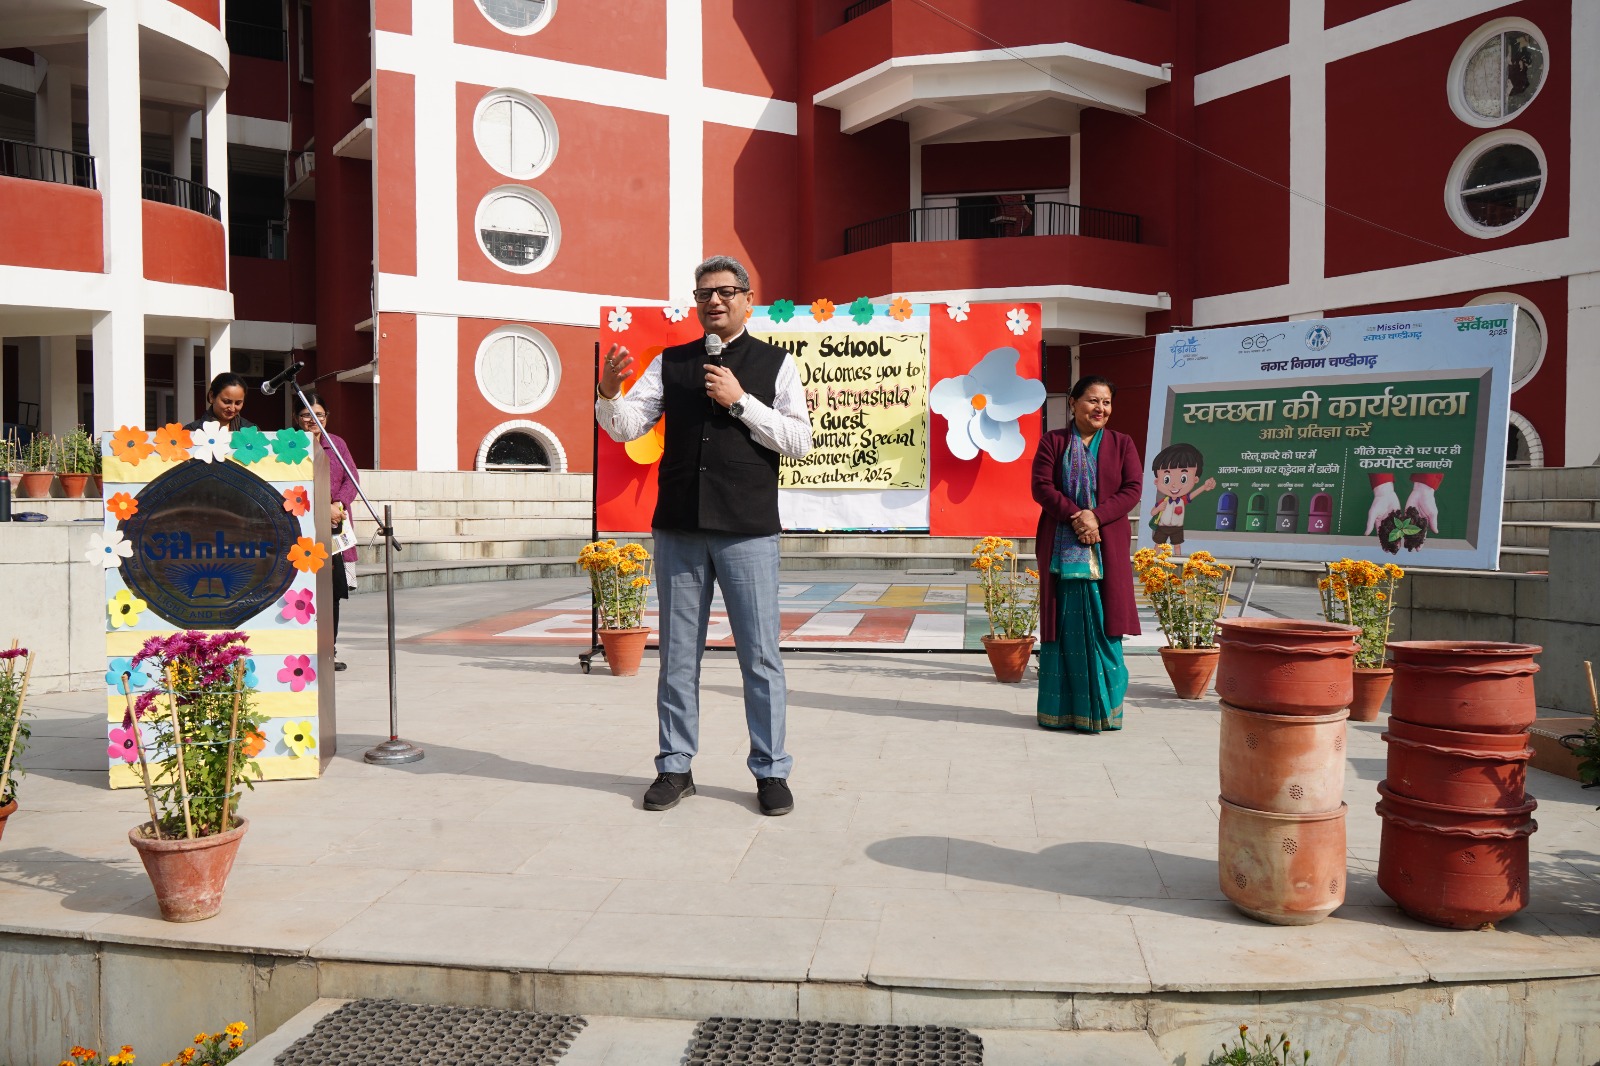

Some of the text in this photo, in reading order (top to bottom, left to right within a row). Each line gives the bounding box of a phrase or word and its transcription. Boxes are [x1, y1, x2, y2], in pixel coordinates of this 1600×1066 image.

[1377, 323, 1411, 331] Mission
[1457, 316, 1508, 332] सर्वेक्षण
[818, 335, 892, 358] School
[1261, 353, 1378, 372] नगर निगम चण्डीगढ़
[876, 365, 902, 384] you
[906, 362, 921, 377] to
[1183, 386, 1470, 424] स्वच्छता की कार्यशाला
[820, 409, 870, 430] Guest
[860, 428, 915, 449] Special
[1259, 422, 1373, 440] आओ प्रतिज्ञा करें
[1282, 450, 1293, 460] को
[1295, 450, 1307, 459] घर
[1307, 448, 1318, 459] में
[1354, 444, 1462, 456] गीले कचरे से घर पर ही
[1264, 465, 1277, 474] कर
[1307, 463, 1317, 474] में
[1359, 455, 1415, 469] कम्पोस्ट
[863, 467, 893, 483] 2025
[156, 593, 187, 615] LIGHT
[189, 610, 212, 619] AND
